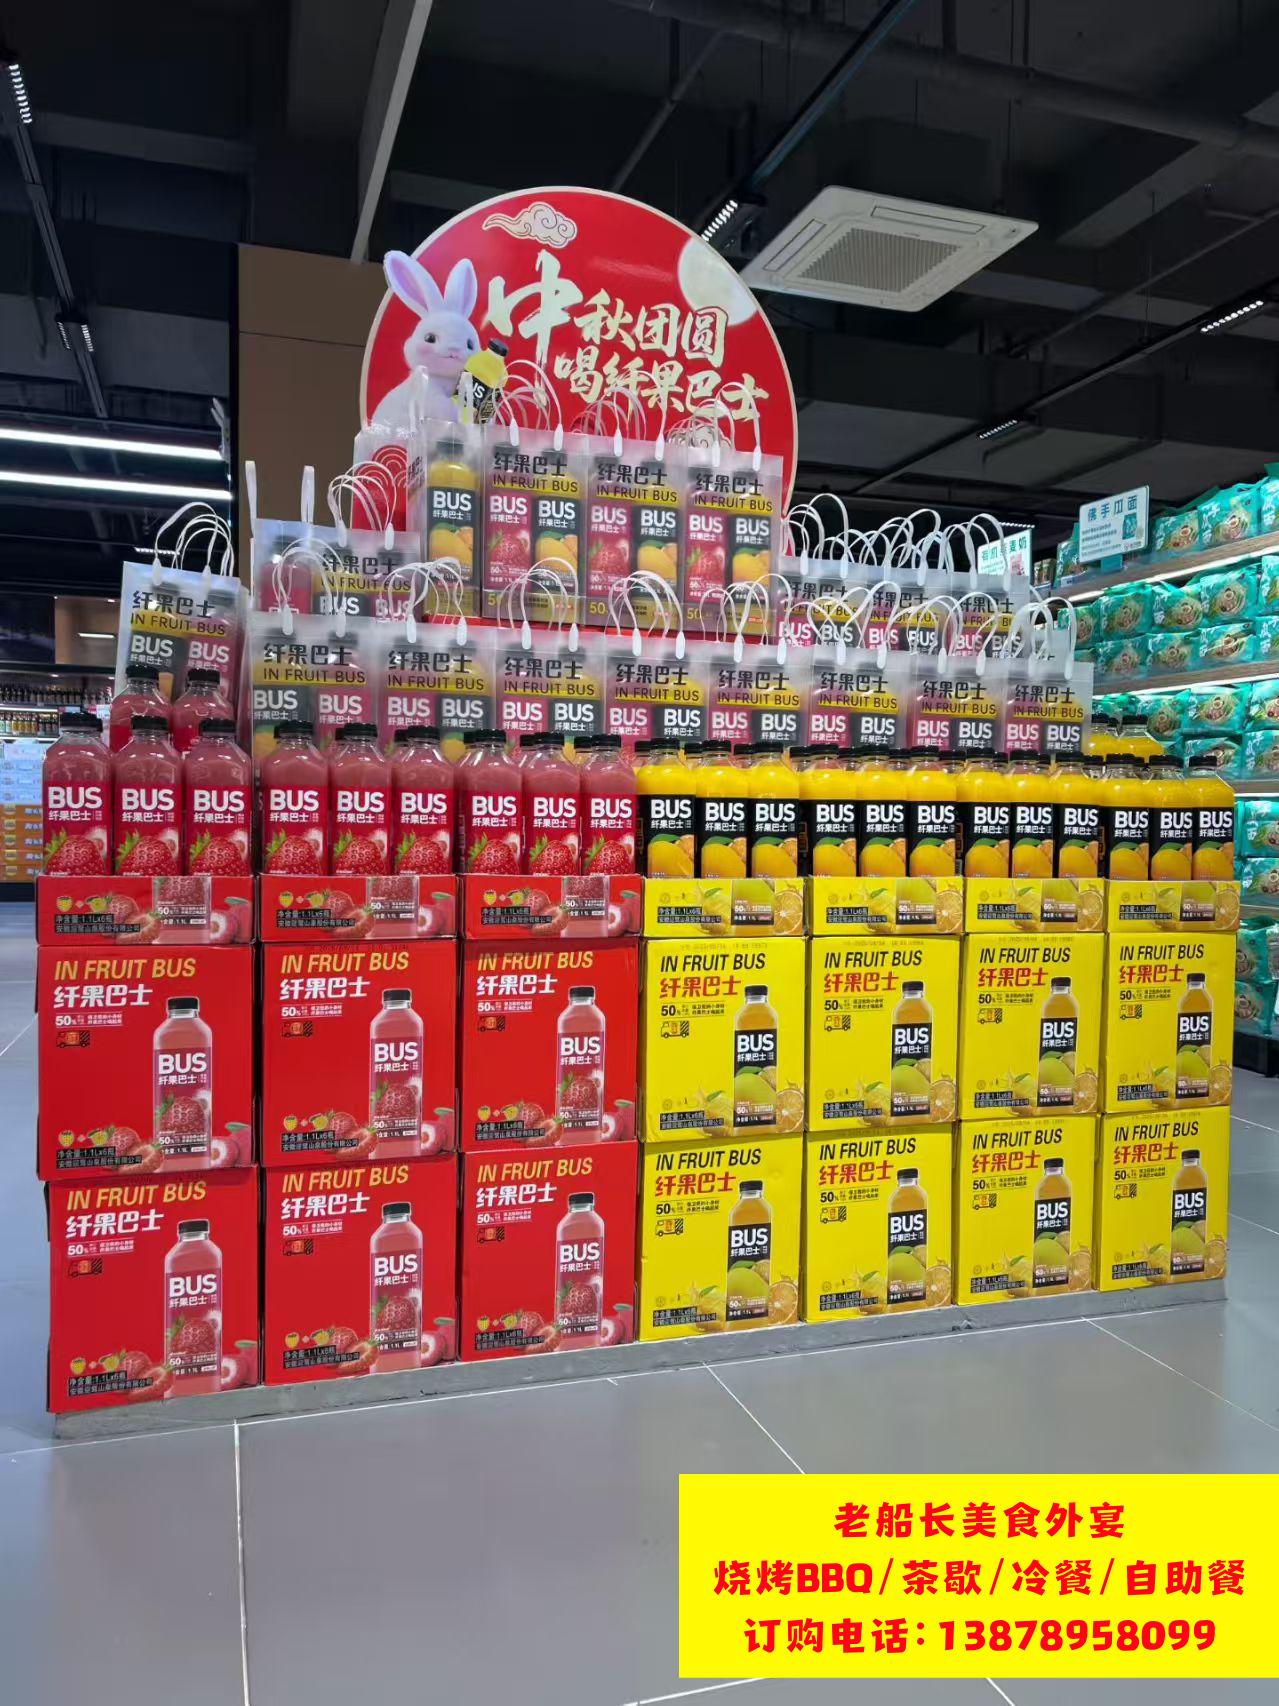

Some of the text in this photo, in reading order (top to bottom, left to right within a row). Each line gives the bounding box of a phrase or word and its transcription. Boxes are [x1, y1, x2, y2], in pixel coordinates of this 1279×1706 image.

[484, 250, 728, 405] 中秋团圆
[494, 452, 567, 478] 纤果巴士
[598, 464, 668, 486] 纤果巴士
[493, 477, 578, 493] IN FRUIT BUS
[696, 474, 764, 496] 纤果巴士
[433, 491, 472, 510] BUS
[689, 514, 723, 533] BUS
[736, 518, 769, 536] BUS
[132, 590, 216, 619] 纤果巴士
[131, 614, 225, 635] IN FRUIT BUS
[263, 643, 352, 667] 纤果巴士
[388, 650, 473, 674] 纤果巴士
[263, 668, 365, 683] IN FRUIT BUS
[504, 657, 583, 680] 纤果巴士
[616, 664, 689, 686] 纤果巴士
[504, 680, 594, 696] IN FRUIT BUS
[719, 670, 789, 690] 纤果巴士
[821, 672, 888, 694] 纤果巴士
[923, 681, 987, 700] 纤果巴士
[1015, 685, 1075, 704] 纤果巴士
[712, 712, 748, 729] BUS
[762, 714, 797, 732] BUS
[1007, 724, 1039, 740] BUS
[1047, 726, 1080, 742] BUS
[48, 787, 102, 809] BUS
[122, 788, 174, 810] BUS
[194, 790, 244, 812] BUS
[270, 790, 319, 812] BUS
[337, 791, 384, 812] BUS
[401, 792, 447, 813] BUS
[472, 796, 516, 816] BUS
[533, 797, 576, 817] BUS
[590, 798, 632, 818] BUS
[49, 811, 92, 822] 纤果巴士
[122, 812, 164, 823] 纤果巴士
[194, 813, 234, 824] 纤果巴士
[270, 813, 309, 823] 纤果巴士
[337, 814, 375, 823] 纤果巴士
[401, 814, 438, 824] 纤果巴士
[651, 799, 691, 819] BUS
[705, 802, 744, 821] BUS
[755, 803, 795, 822] BUS
[816, 804, 854, 822] BUS
[866, 805, 904, 823] BUS
[918, 805, 955, 823] BUS
[974, 806, 1009, 824] BUS
[1016, 806, 1052, 824] BUS
[1064, 808, 1098, 826] BUS
[472, 817, 507, 827] 纤果巴士
[533, 819, 568, 828] 纤果巴士
[590, 819, 623, 828] 纤果巴士
[1115, 811, 1148, 828] BUS
[1160, 812, 1192, 829] BUS
[1200, 811, 1232, 828] BUS
[478, 951, 593, 971] IN FRUIT BUS
[824, 950, 922, 969] IN FRUIT BUS
[980, 948, 1071, 963] IN FRUIT BUS
[1120, 944, 1204, 960] IN FRUIT BUS
[54, 958, 197, 980] IN FRUIT BUS
[281, 952, 410, 974] IN FRUIT BUS
[660, 953, 766, 972] IN FRUIT BUS
[824, 971, 899, 993] 纤果巴士
[978, 967, 1048, 987] 纤果巴士
[1119, 964, 1184, 984] 纤果巴士
[280, 976, 370, 1000] 纤果巴士
[476, 974, 558, 996] 纤果巴士
[660, 975, 741, 999] 纤果巴士
[53, 984, 153, 1008] 纤果巴士
[1043, 1022, 1074, 1038] BUS
[1180, 1016, 1209, 1032] BUS
[560, 1037, 600, 1056] BUS
[737, 1034, 774, 1053] BUS
[895, 1028, 929, 1045] BUS
[374, 1042, 418, 1062] BUS
[158, 1053, 207, 1074] BUS
[973, 1128, 1062, 1150] IN FRUIT BUS
[1115, 1121, 1199, 1141] IN FRUIT BUS
[820, 1138, 916, 1161] IN FRUIT BUS
[1114, 1141, 1179, 1165] 纤果巴士
[477, 1157, 593, 1183] IN FRUIT BUS
[656, 1149, 761, 1171] IN FRUIT BUS
[972, 1150, 1041, 1174] 纤果巴士
[282, 1166, 409, 1193] IN FRUIT BUS
[819, 1160, 894, 1186] 纤果巴士
[655, 1172, 736, 1197] 纤果巴士
[67, 1181, 207, 1211] IN FRUIT BUS
[476, 1182, 557, 1208] 纤果巴士
[1174, 1192, 1204, 1209] BUS
[281, 1192, 370, 1219] 纤果巴士
[1037, 1202, 1068, 1220] BUS
[66, 1209, 164, 1238] 纤果巴士
[890, 1214, 924, 1234] BUS
[731, 1228, 768, 1248] BUS
[560, 1243, 599, 1262] BUS
[374, 1254, 417, 1276] BUS
[169, 1274, 217, 1297] BUS
